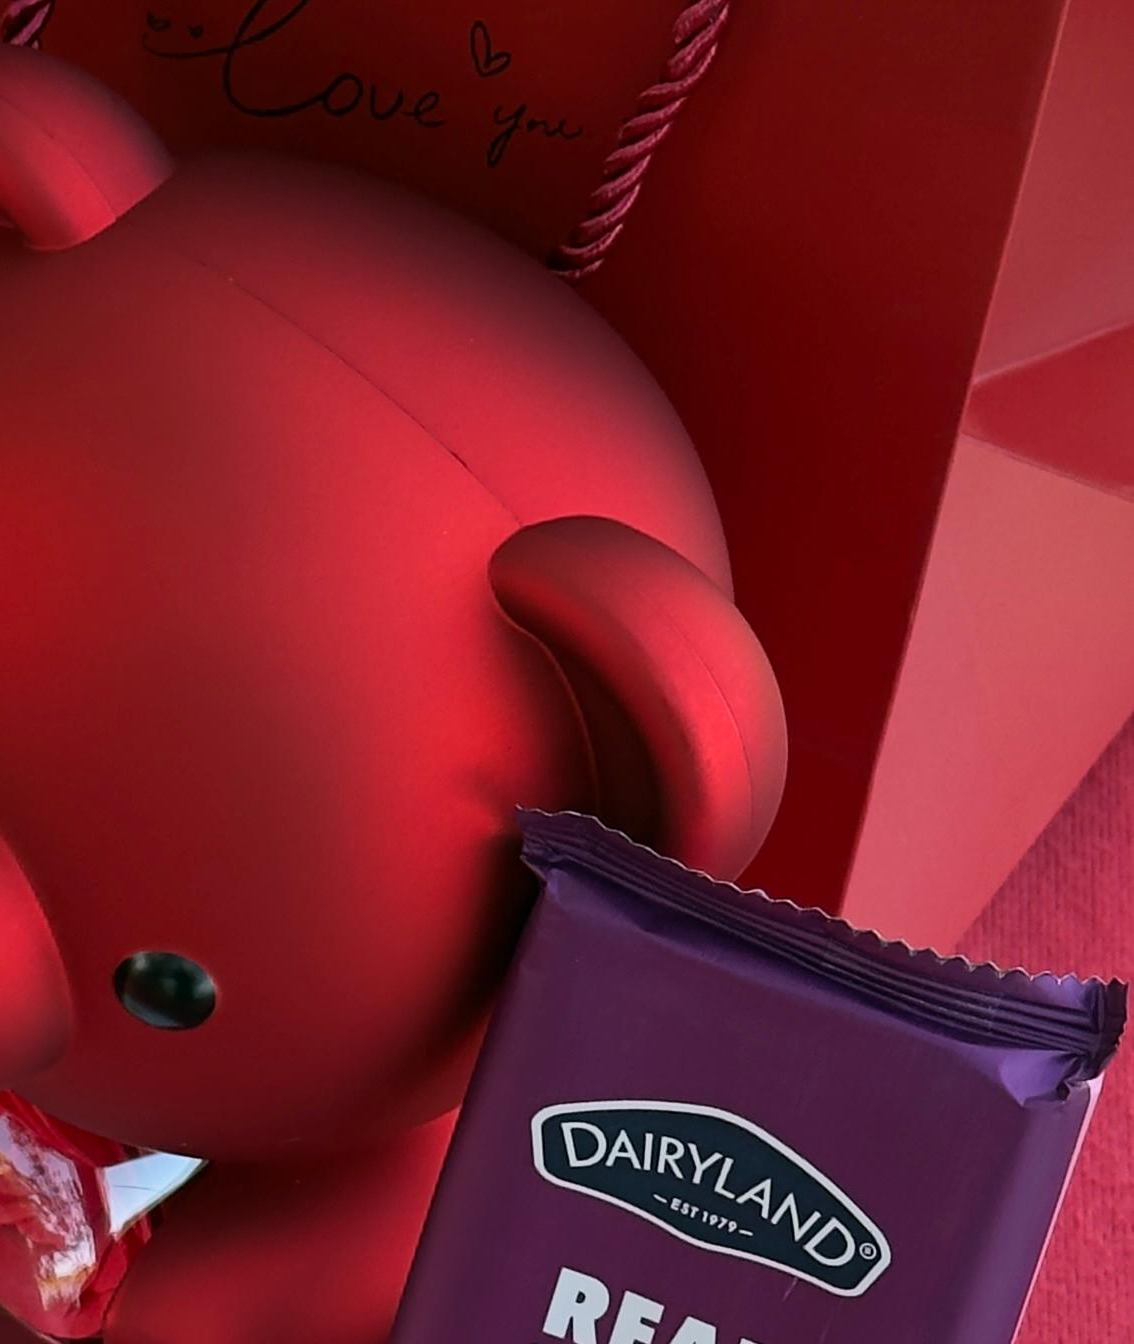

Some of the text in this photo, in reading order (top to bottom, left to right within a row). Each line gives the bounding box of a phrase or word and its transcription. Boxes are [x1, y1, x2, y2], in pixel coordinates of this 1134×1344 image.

[486, 103, 584, 167] you
[670, 1197, 738, 1233] EST 1979
